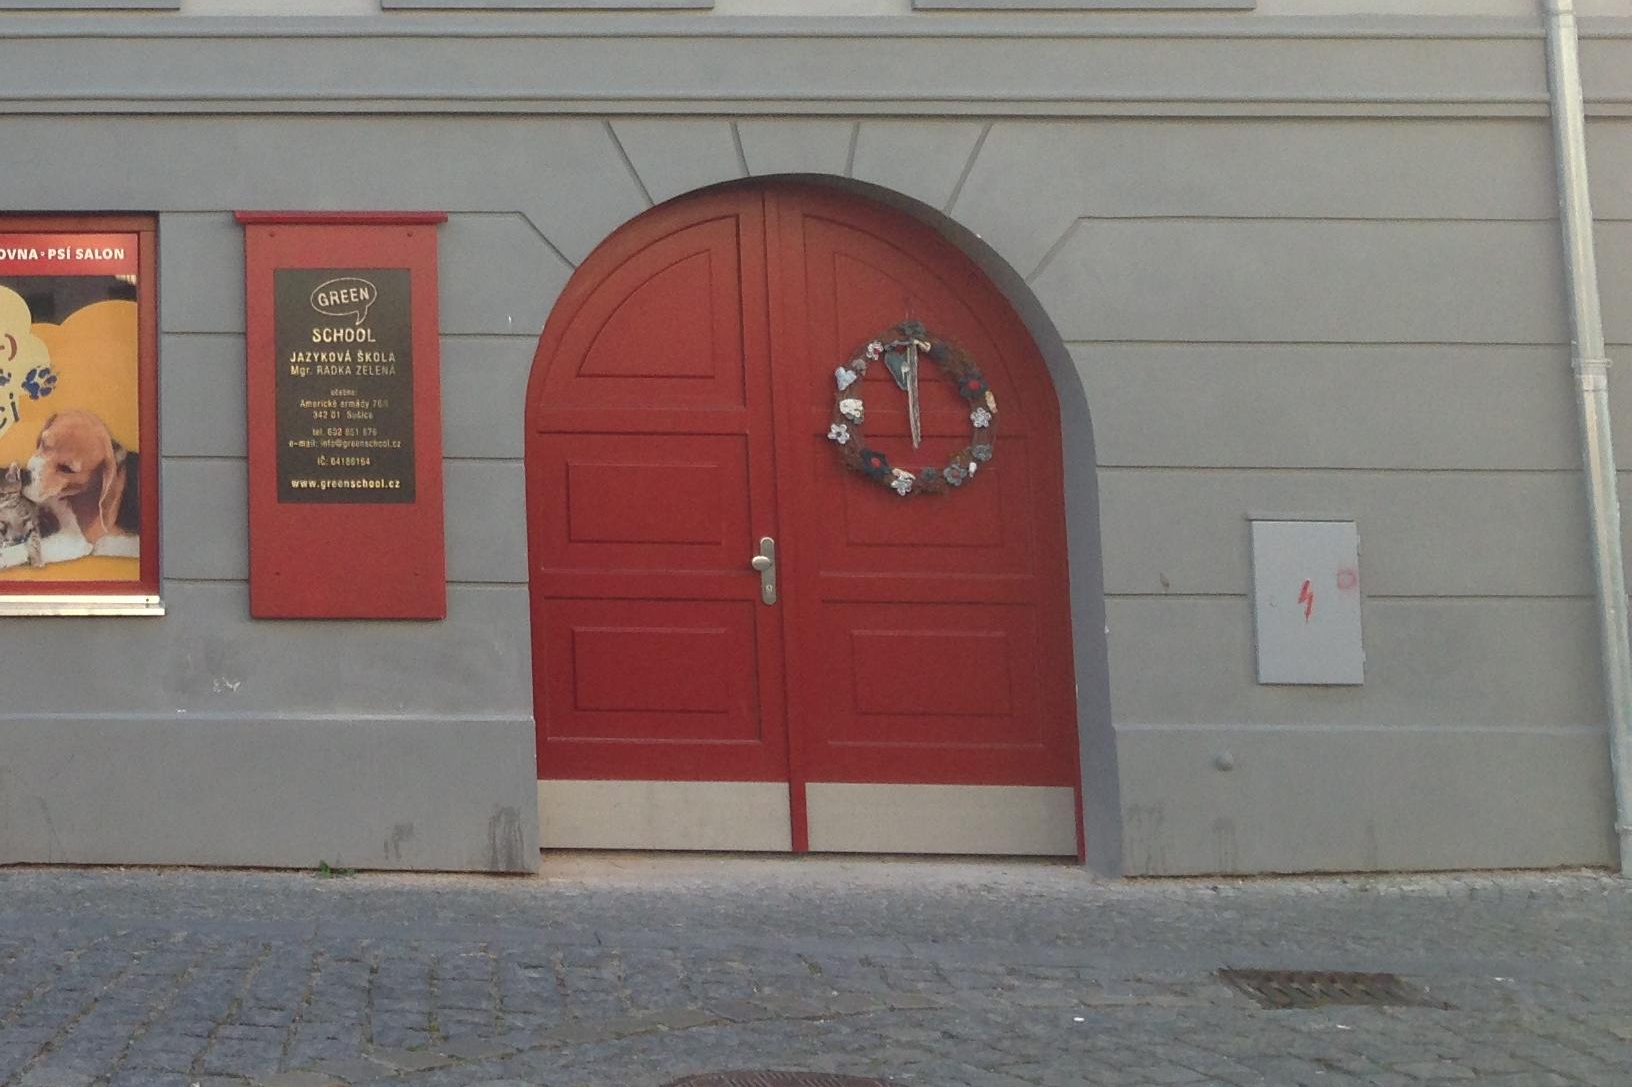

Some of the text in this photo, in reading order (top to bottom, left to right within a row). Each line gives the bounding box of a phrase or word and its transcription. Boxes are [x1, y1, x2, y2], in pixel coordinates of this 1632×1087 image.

[48, 247, 71, 260] PSÍ
[76, 248, 124, 260] SALON
[317, 287, 370, 307] GREEN
[312, 327, 377, 343] SCHOOL
[290, 349, 396, 363] JAZYKOVÁ ŠKOLA
[316, 365, 352, 376] RADKA
[355, 364, 396, 376] ZELENÁ
[291, 478, 401, 490] www.greenschool.cz
